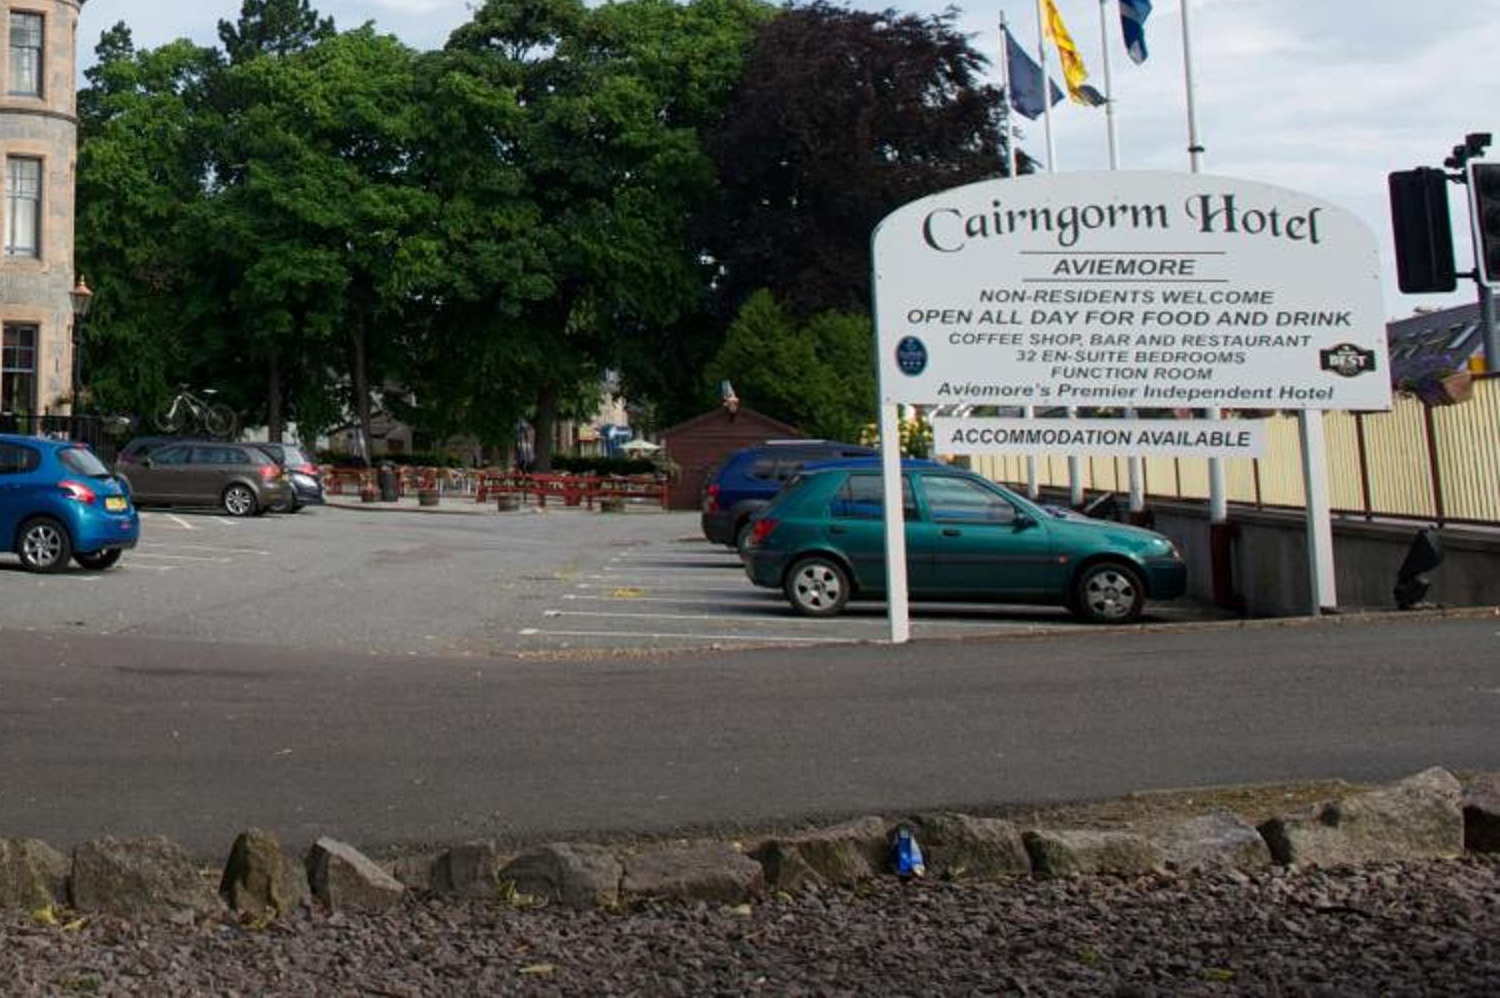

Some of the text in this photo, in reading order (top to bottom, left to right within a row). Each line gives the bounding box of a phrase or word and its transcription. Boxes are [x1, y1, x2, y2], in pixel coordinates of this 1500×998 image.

[922, 193, 1324, 253] Cairngorm Hotel
[1052, 258, 1197, 276] AVIEMORE
[979, 289, 1275, 305] NON-RESIDENTS WELCOME
[906, 309, 1353, 327] OPEN ALL DAY FOR FOOD AND DRINK
[948, 332, 1024, 345] COFFEE
[1089, 333, 1132, 346] BAR
[1134, 334, 1176, 347] AND
[1180, 334, 1312, 348] RESTAURANT
[1015, 349, 1247, 365] 32 EN-SUITE BEDROOMS
[1329, 354, 1368, 367] BEST
[1050, 366, 1214, 381] FUNCTION ROOM
[937, 382, 1335, 403] Aviemore's Premier Independent Hotel
[951, 428, 1252, 448] ACCOMMODATION AVAILABLE
